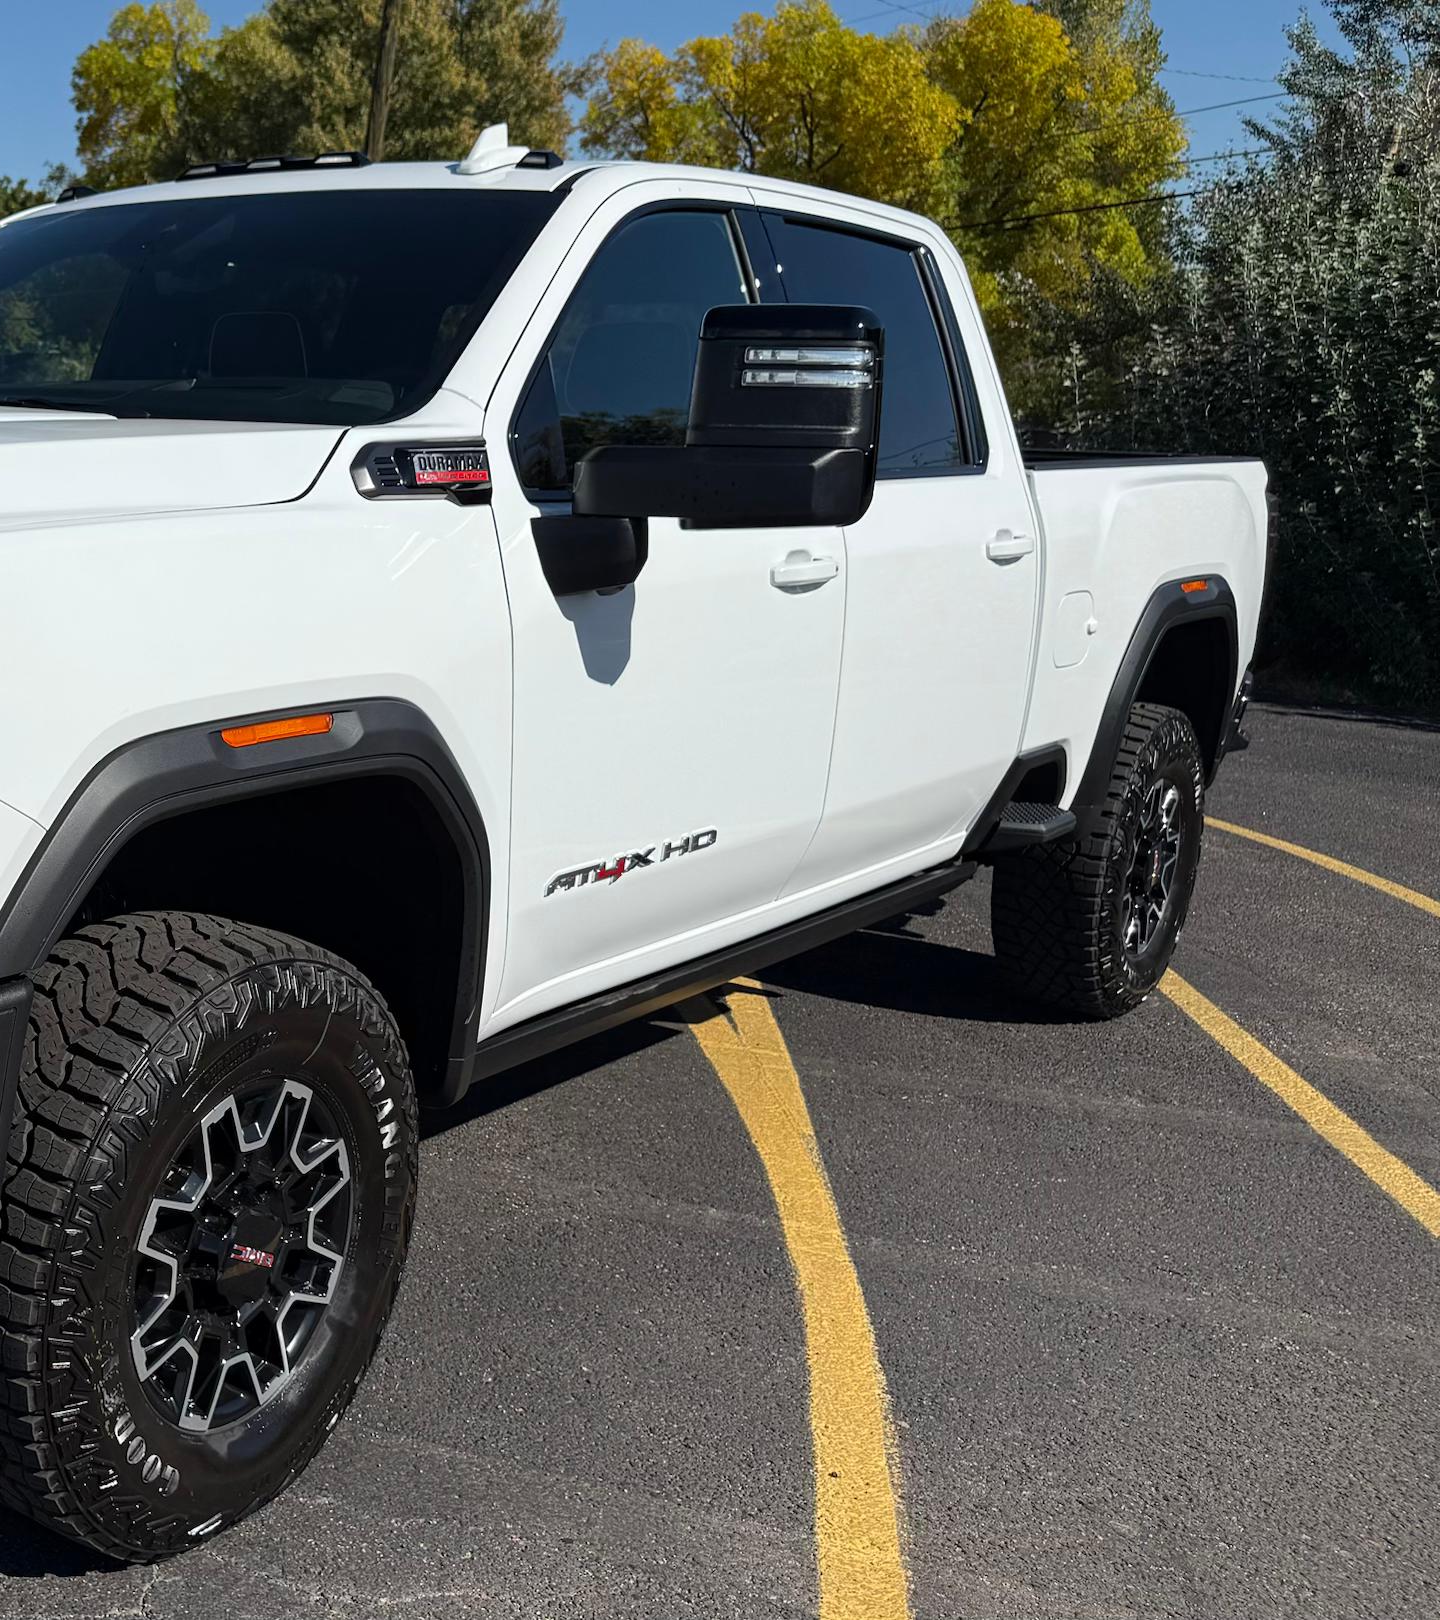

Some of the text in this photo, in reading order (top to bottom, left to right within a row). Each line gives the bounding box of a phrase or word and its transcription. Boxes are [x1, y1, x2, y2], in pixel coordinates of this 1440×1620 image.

[416, 453, 483, 471] DURAMAX
[544, 826, 717, 897] AT4X HD
[231, 1243, 274, 1268] GMC
